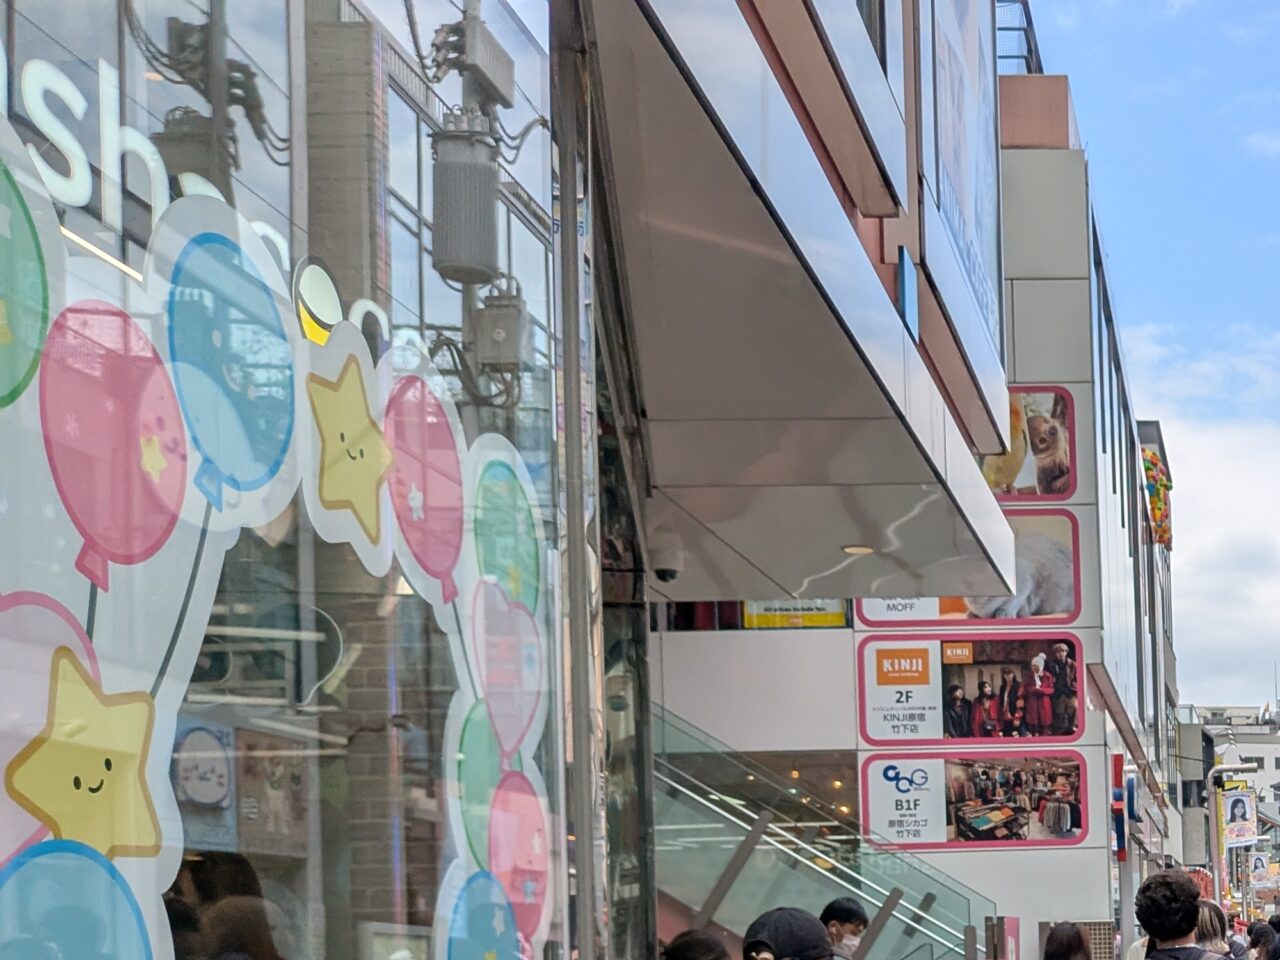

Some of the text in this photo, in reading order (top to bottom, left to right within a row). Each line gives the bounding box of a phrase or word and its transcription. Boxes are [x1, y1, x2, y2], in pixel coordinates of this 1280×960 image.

[886, 603, 916, 613] MOFF
[946, 647, 969, 657] KINJI
[882, 657, 923, 672] KINJI
[895, 690, 913, 704] 2F
[883, 713, 926, 723] KINJI原宿
[891, 724, 919, 735] 竹下店
[895, 799, 921, 812] B1F
[896, 829, 921, 839] 竹下店
